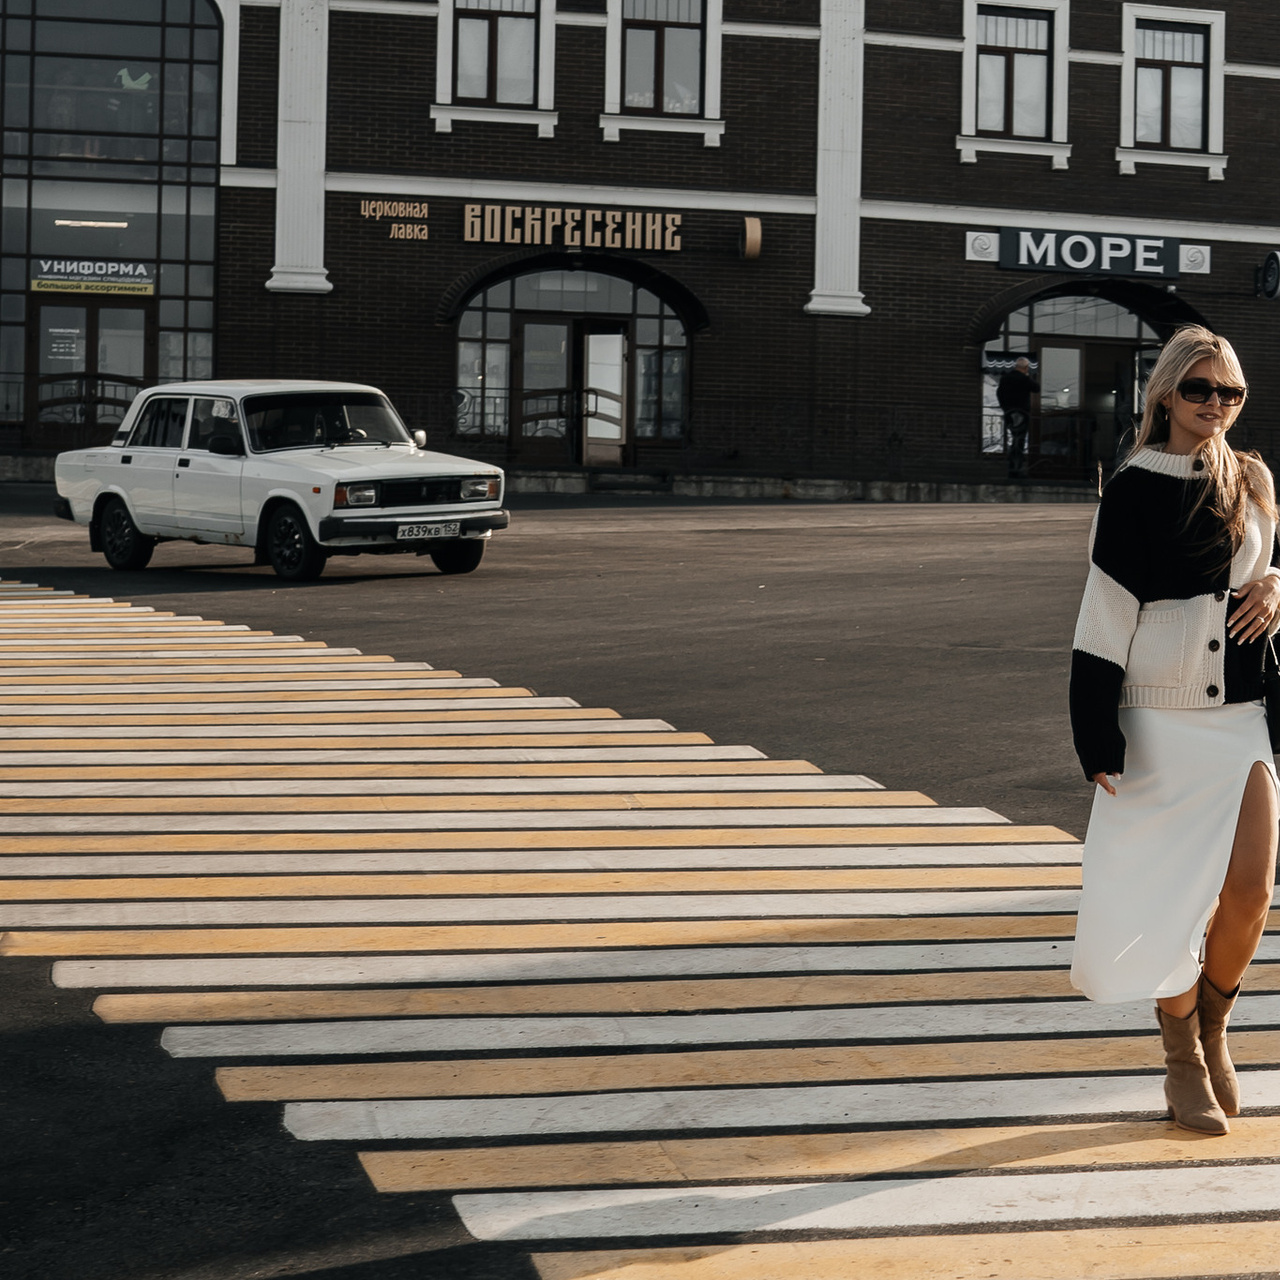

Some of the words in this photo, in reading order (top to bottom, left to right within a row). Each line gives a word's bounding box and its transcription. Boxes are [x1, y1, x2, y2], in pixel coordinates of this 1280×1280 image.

[360, 200, 429, 220] церковная
[389, 223, 429, 240] лавка
[464, 204, 682, 251] ВОСКРЕСЕНИЕ
[1018, 231, 1164, 274] МОРЕ
[39, 259, 148, 276] УНИФОРМА
[37, 281, 82, 290] большой
[441, 524, 458, 533] 152
